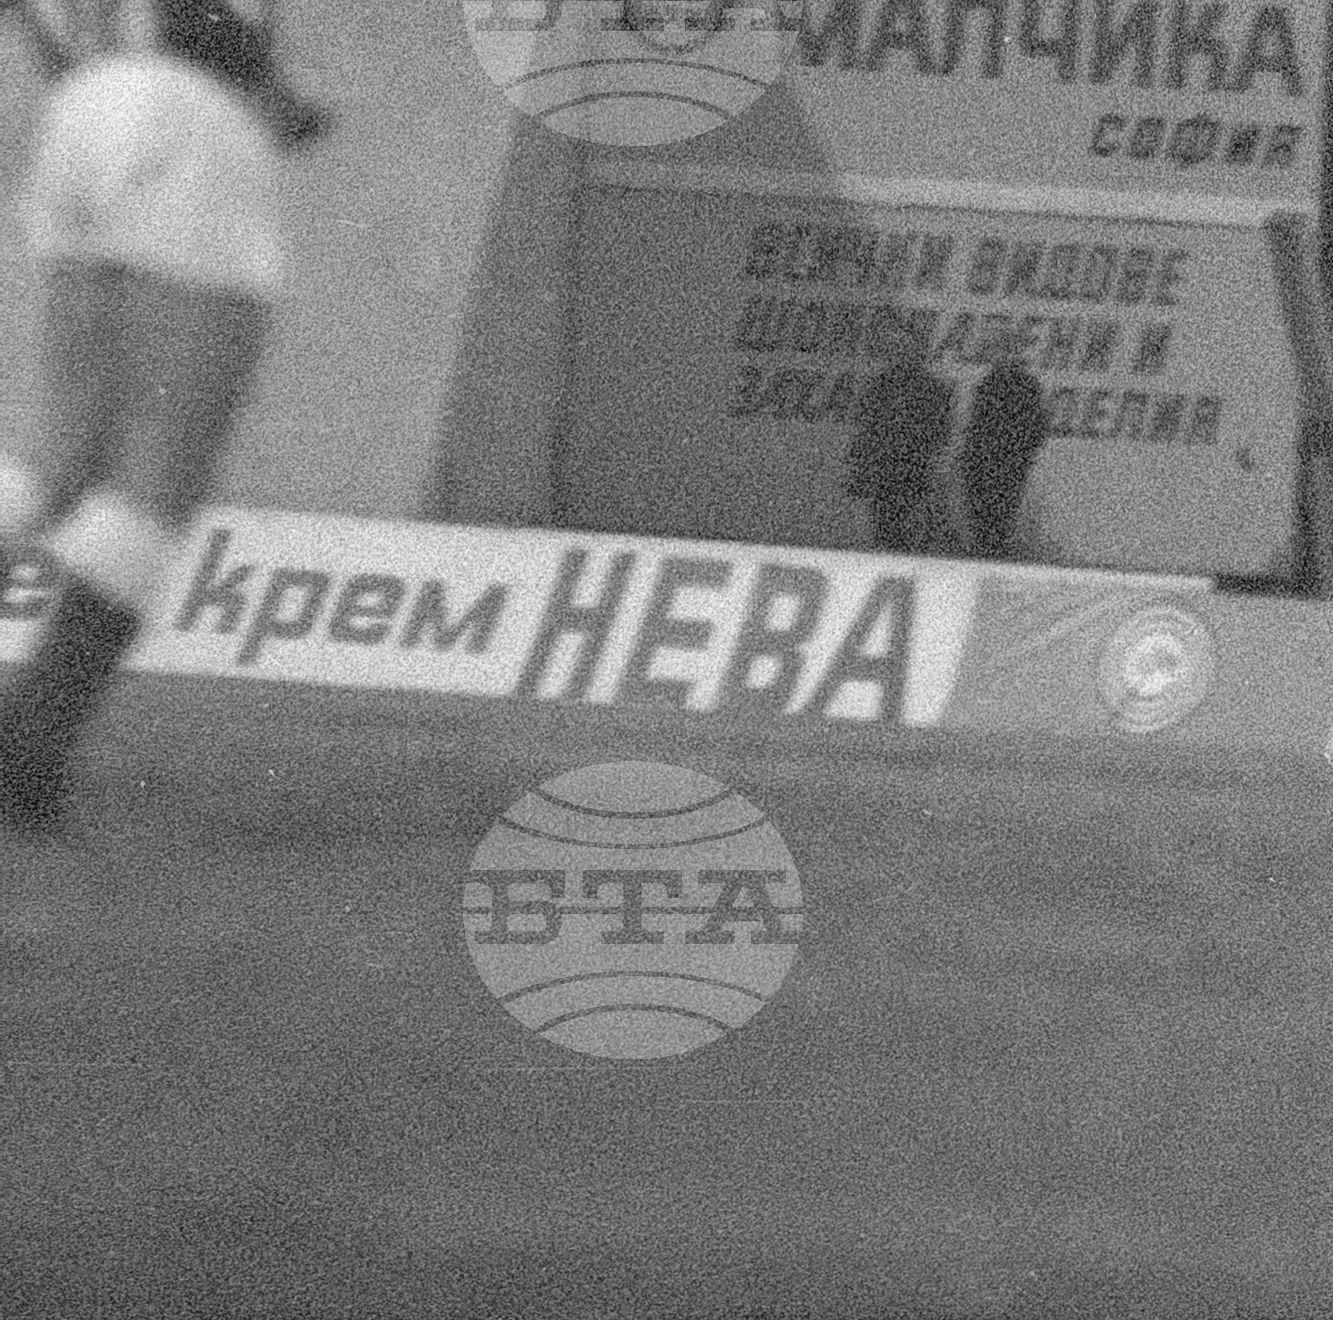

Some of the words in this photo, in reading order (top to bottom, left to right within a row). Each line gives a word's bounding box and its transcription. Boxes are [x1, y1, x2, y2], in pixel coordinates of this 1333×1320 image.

[1089, 112, 1304, 167] СОФИЯ
[964, 237, 1190, 308] ВИДОВЕ
[1042, 384, 1226, 448] ДЕЛИЯ
[523, 546, 918, 724] НЕВА
